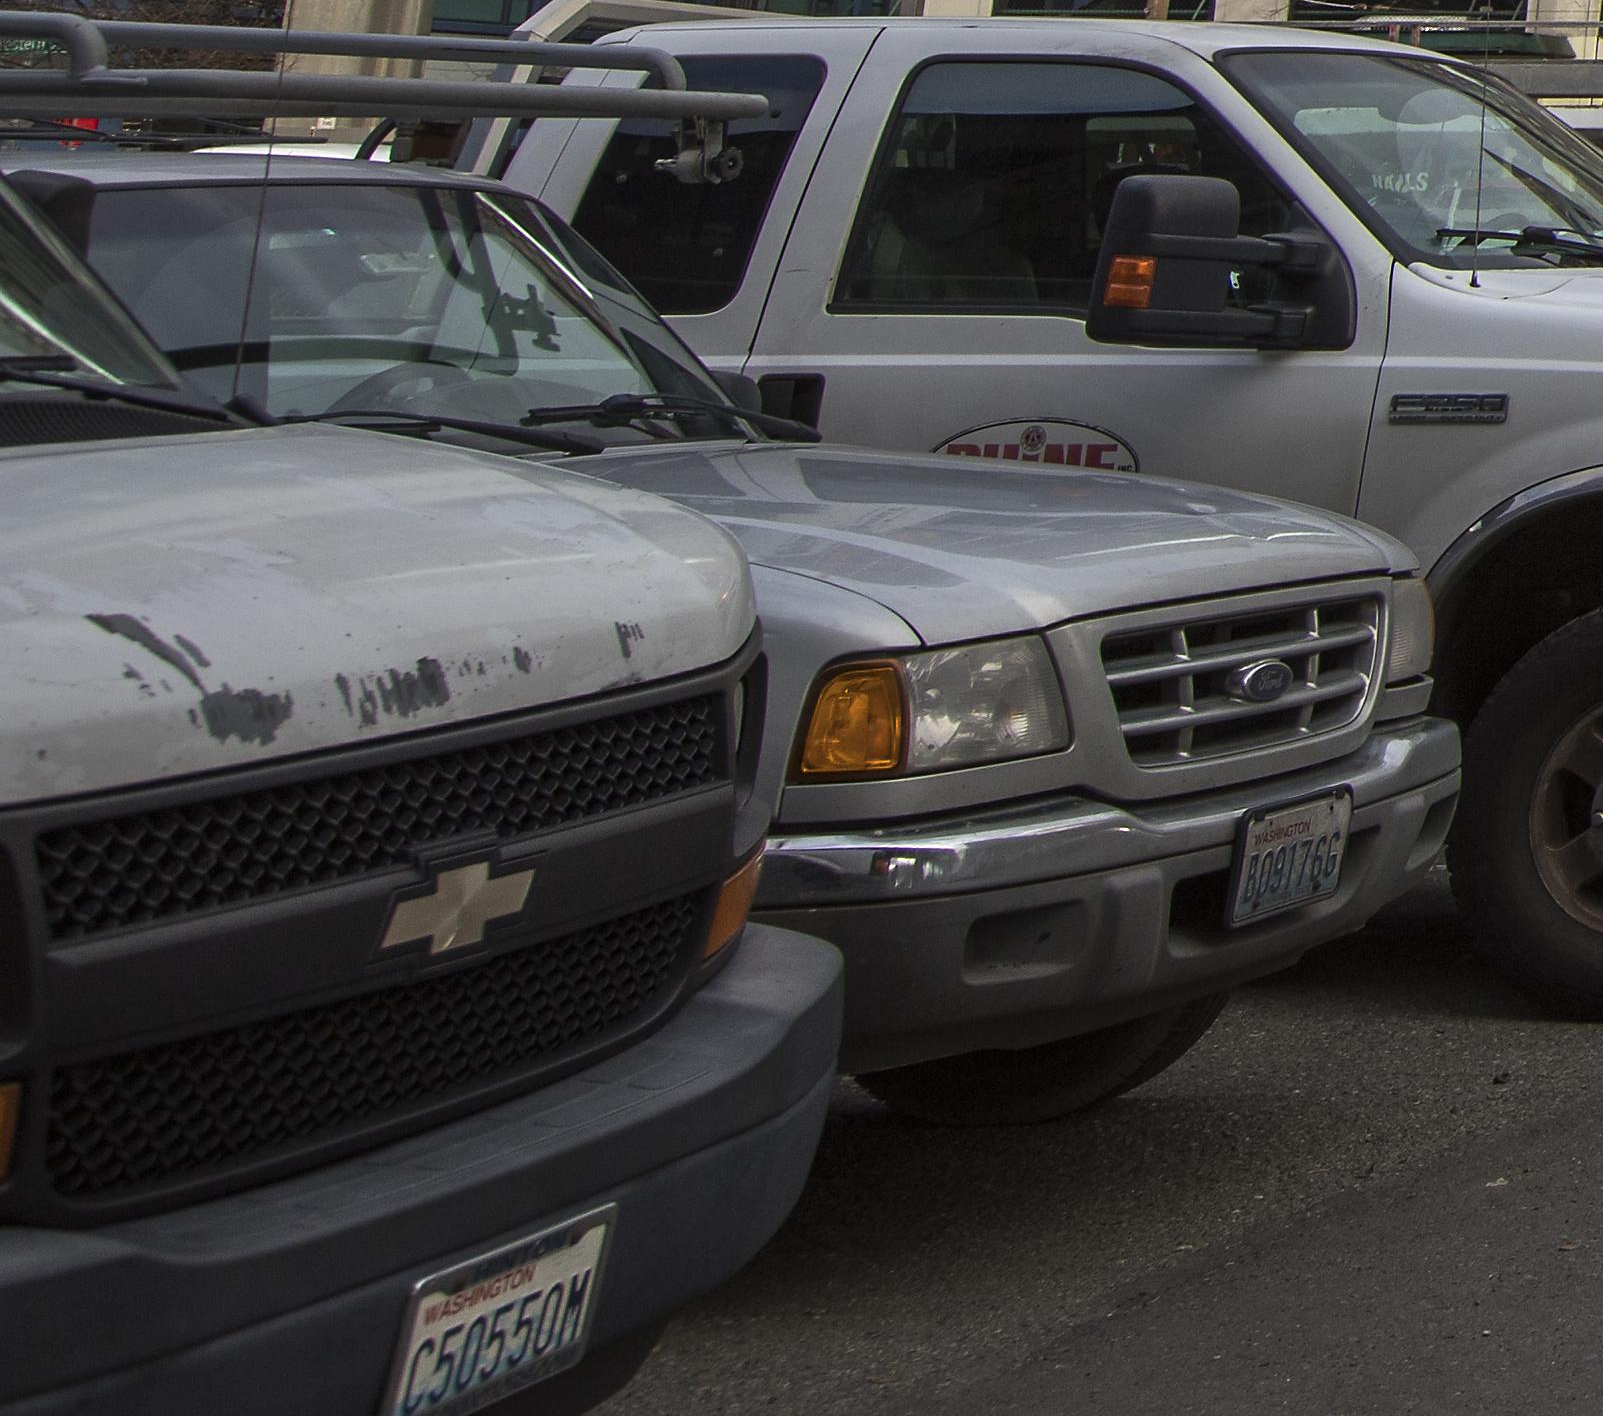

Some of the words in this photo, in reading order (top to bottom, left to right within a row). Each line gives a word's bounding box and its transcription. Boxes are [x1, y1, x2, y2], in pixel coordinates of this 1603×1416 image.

[1371, 172, 1429, 193] NAILS
[1258, 671, 1284, 691] Ford
[1254, 818, 1312, 847] WASHINGTON
[1244, 831, 1341, 903] B09176G
[424, 1264, 537, 1325] WASHINGTON
[402, 1268, 593, 1415] C50550M
